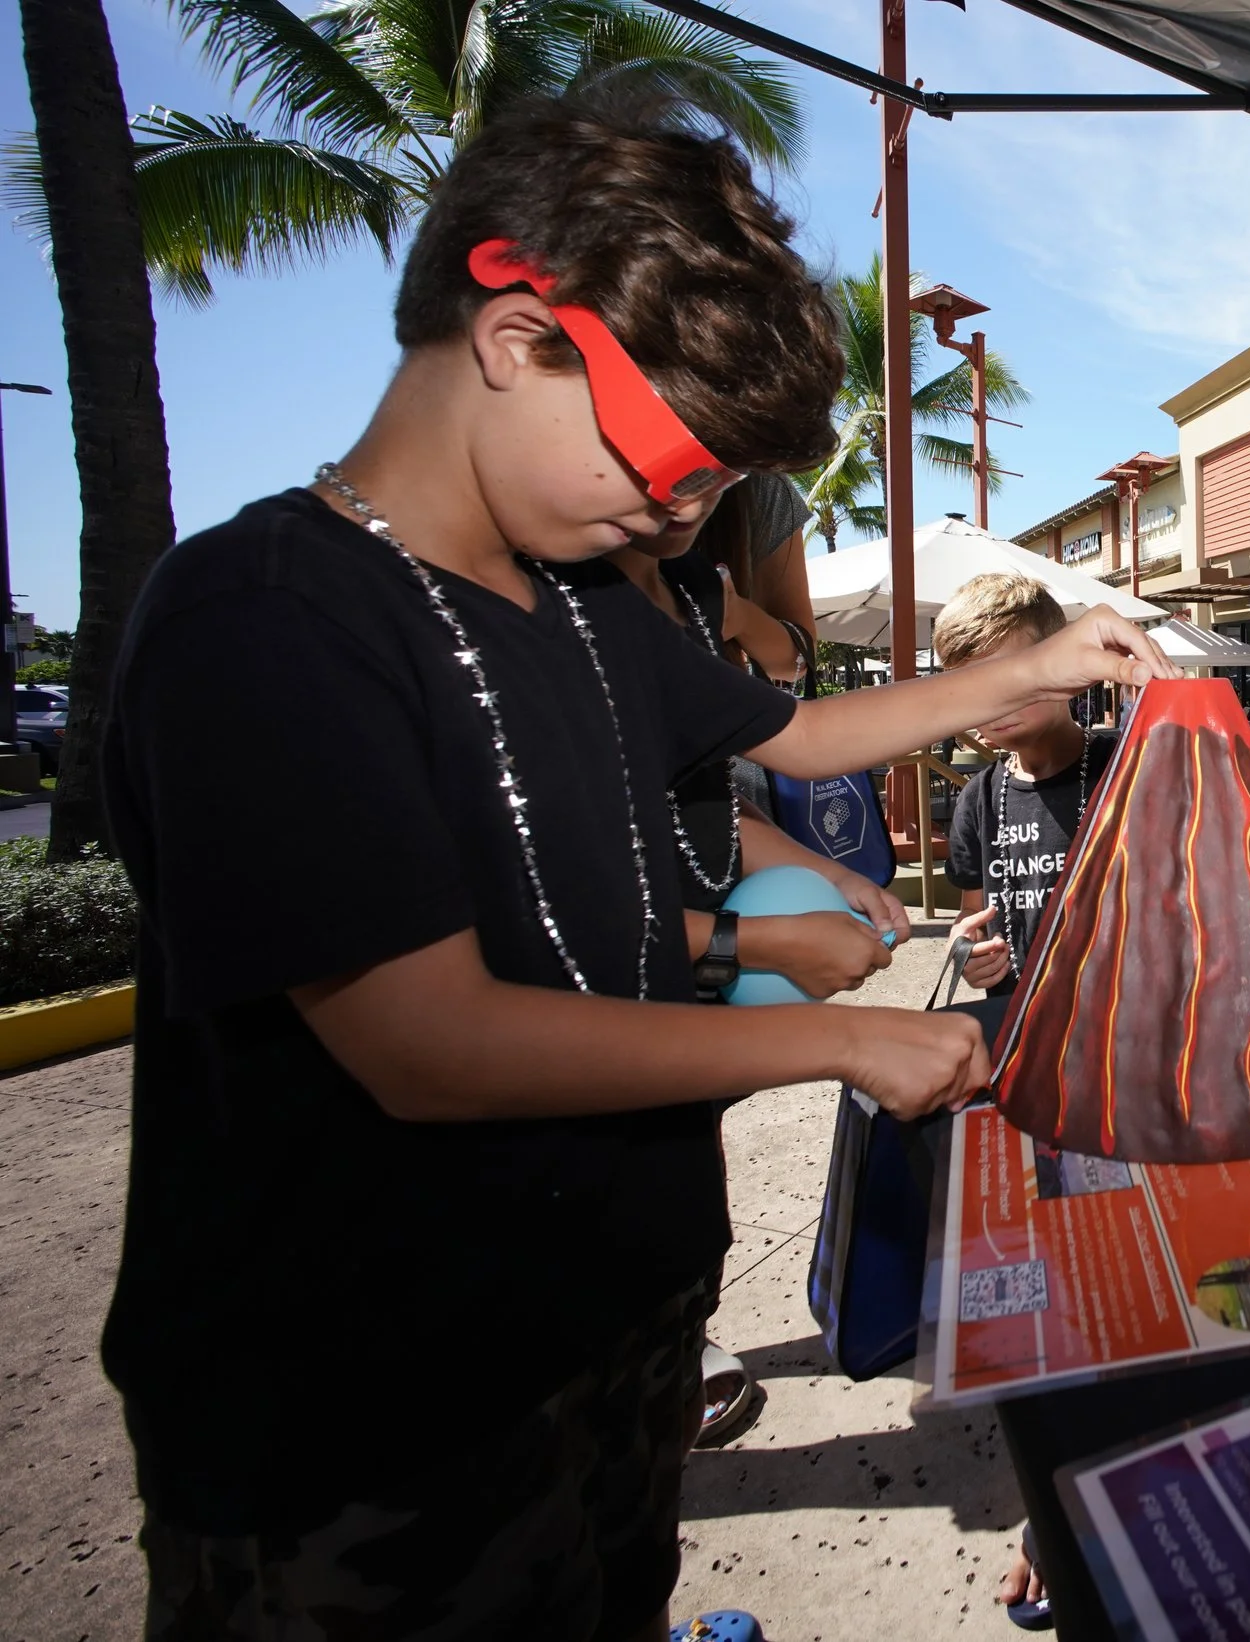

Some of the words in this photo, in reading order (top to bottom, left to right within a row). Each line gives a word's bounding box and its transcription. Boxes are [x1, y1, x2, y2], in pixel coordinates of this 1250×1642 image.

[1080, 531, 1101, 558] KONA
[814, 786, 848, 802] OBSERVATORY
[826, 780, 842, 790] KECK
[991, 822, 1040, 846] JESUS
